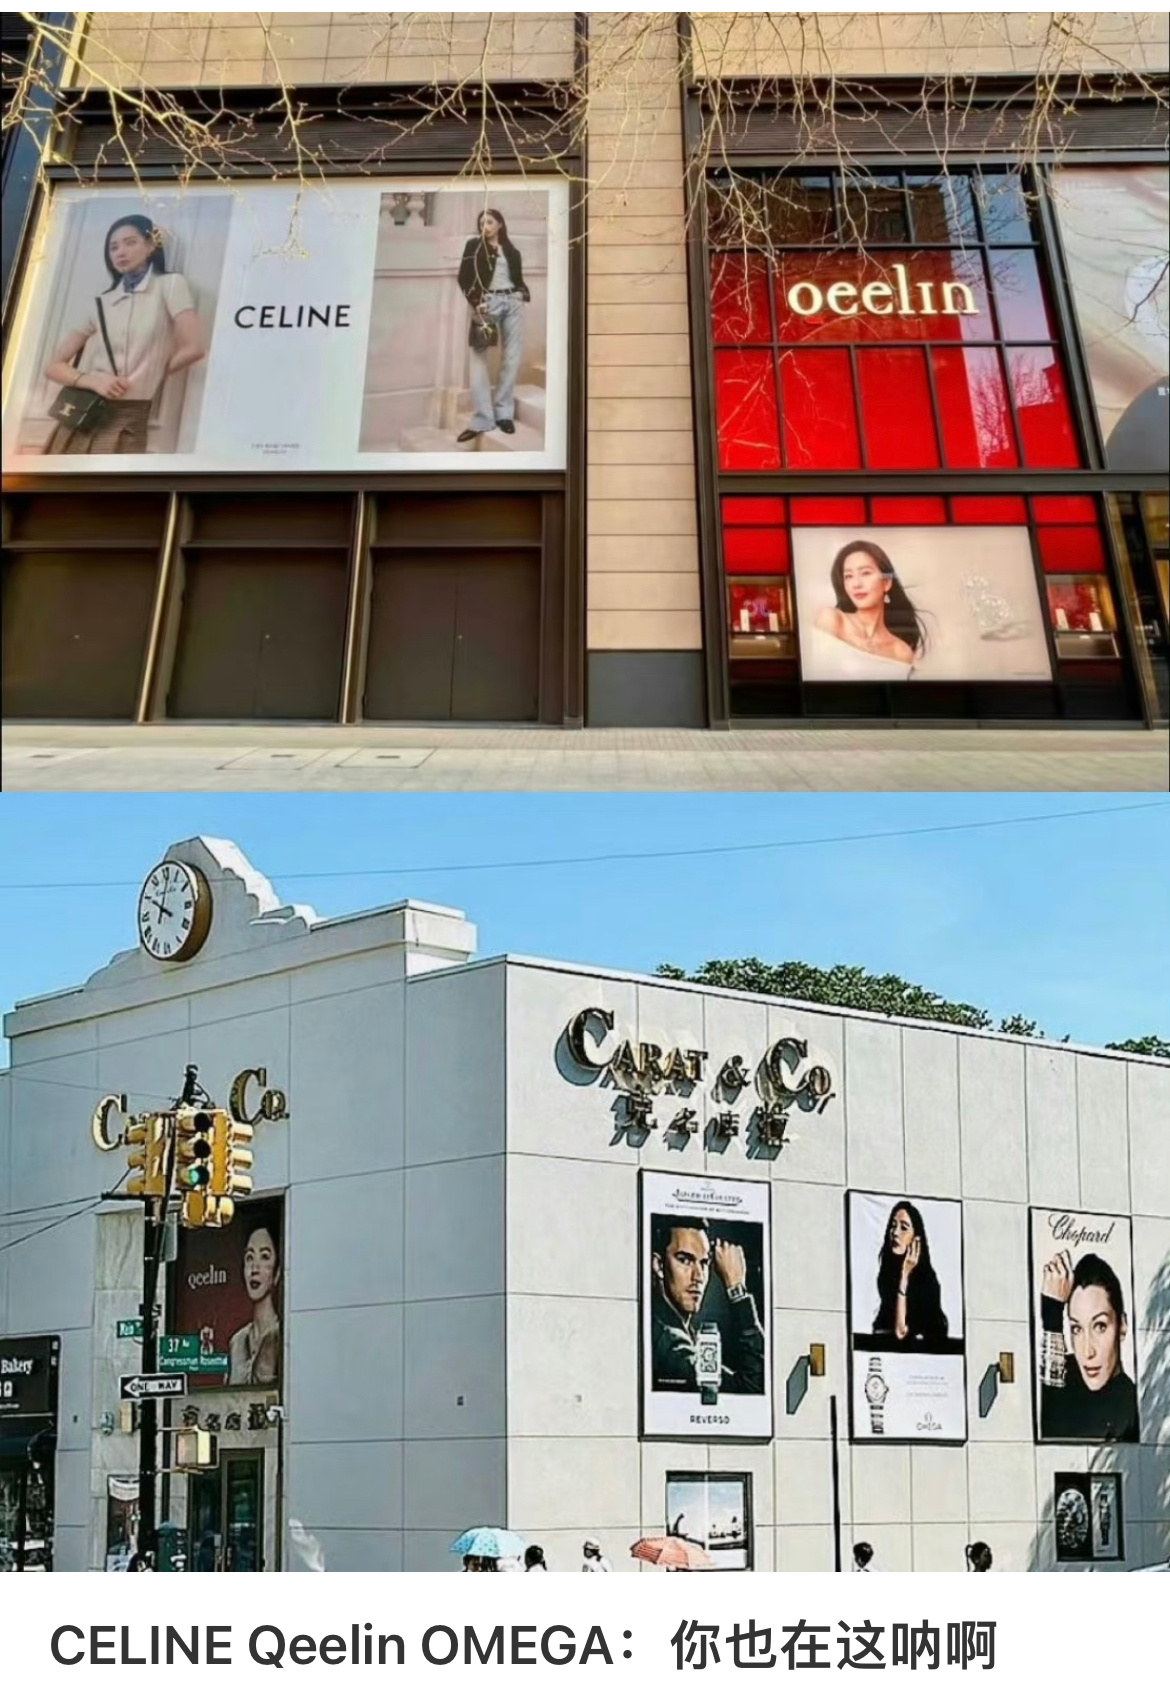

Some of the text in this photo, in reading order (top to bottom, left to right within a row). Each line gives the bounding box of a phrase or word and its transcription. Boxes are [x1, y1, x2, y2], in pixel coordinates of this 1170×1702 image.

[234, 305, 351, 329] CELINE
[719, 1055, 751, 1088] &
[1048, 1213, 1115, 1248] Chopard
[168, 1338, 180, 1353] 37
[1, 1358, 33, 1375] Bakery
[130, 1380, 178, 1392] ONE WAY
[690, 1415, 730, 1424] REVERSO
